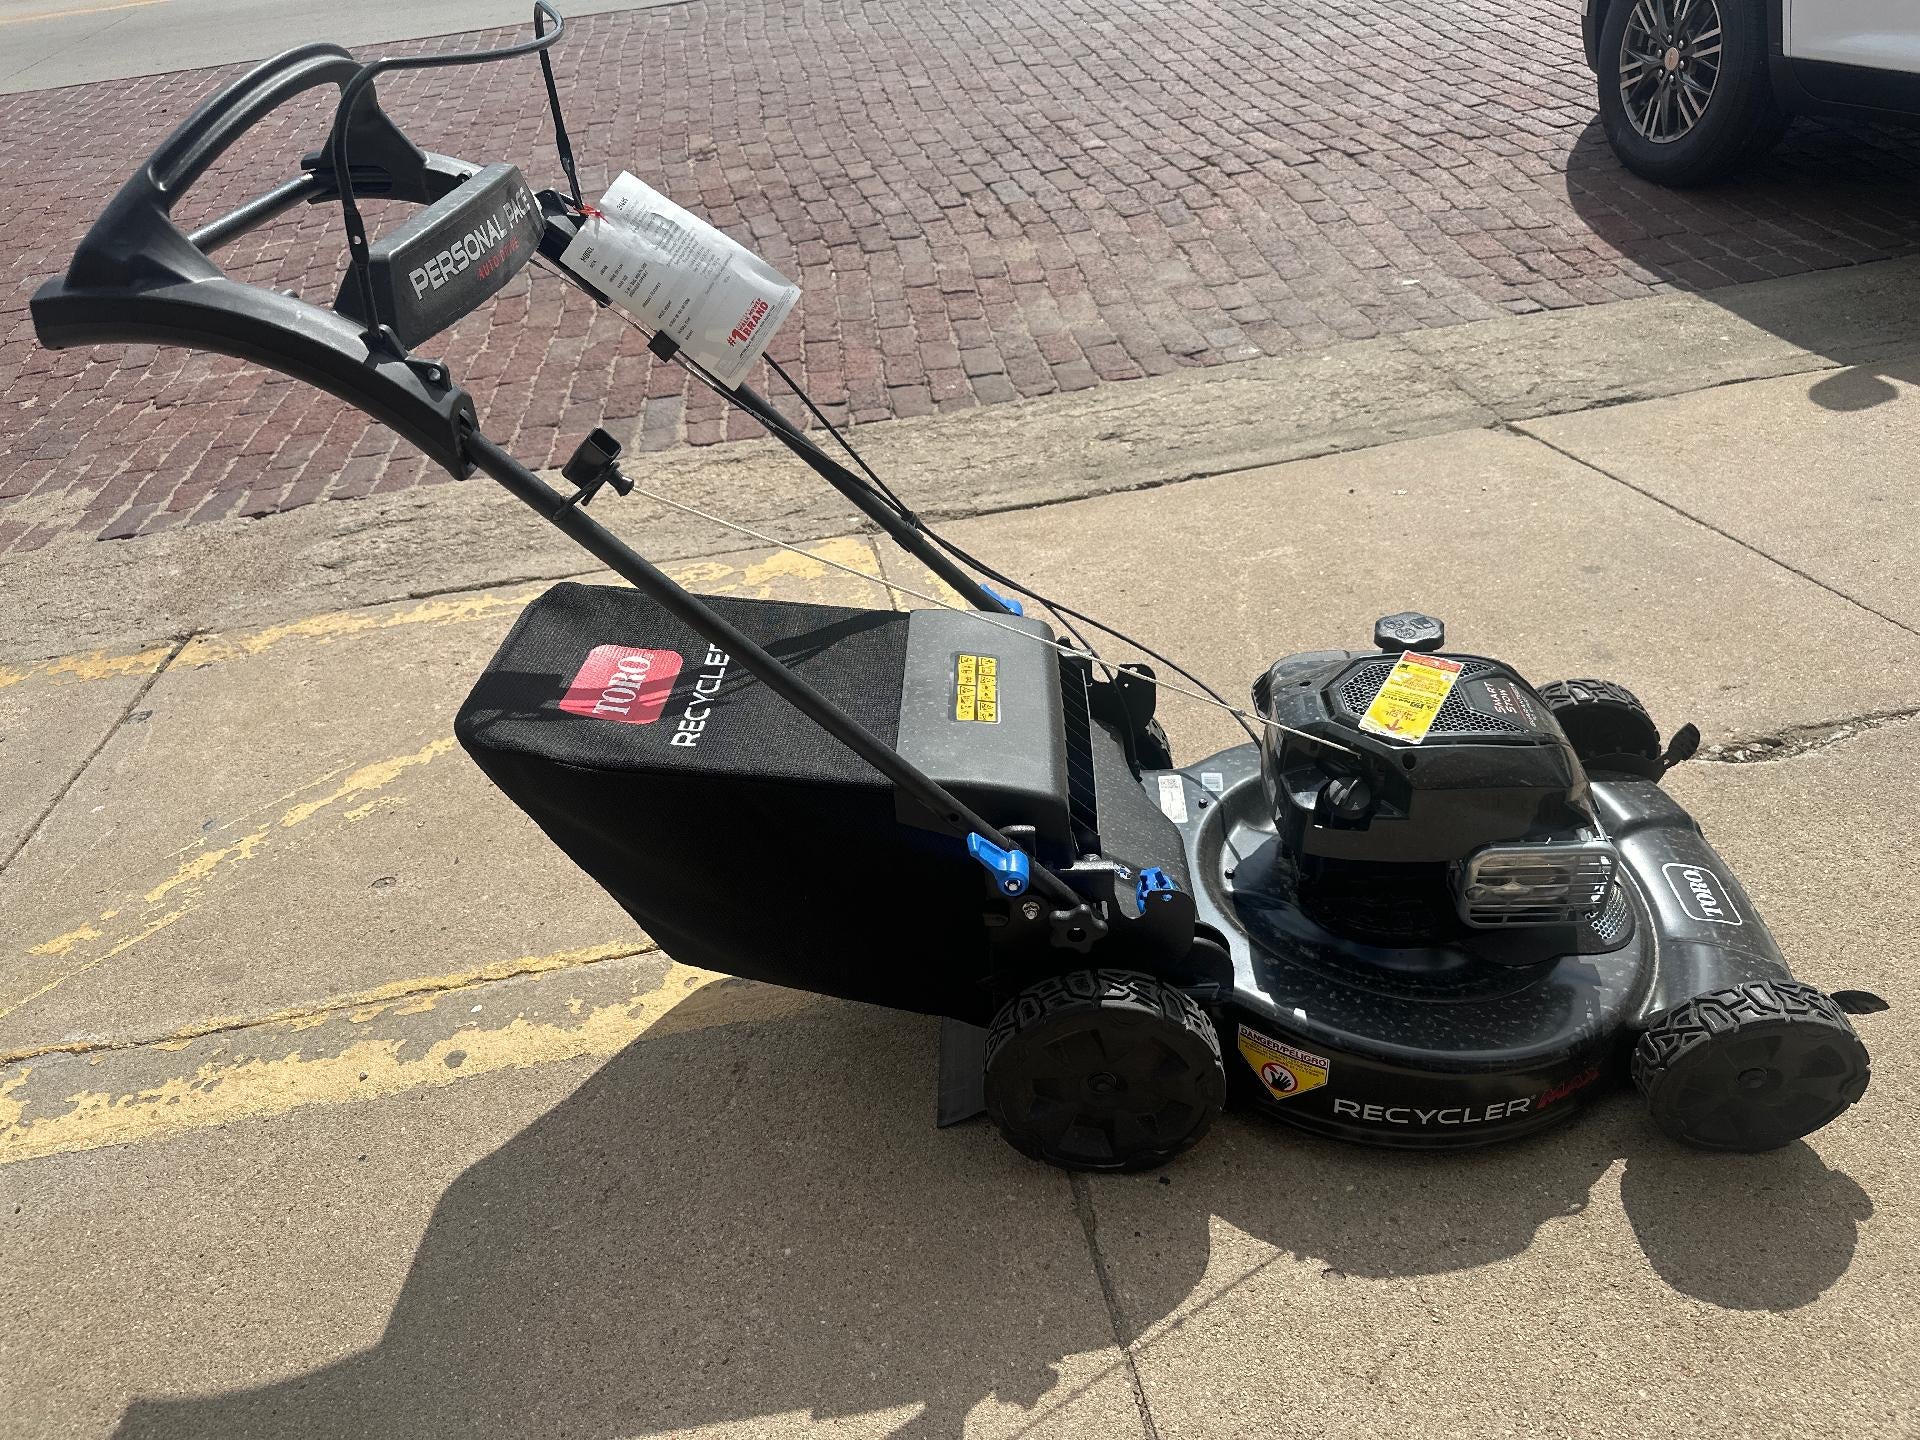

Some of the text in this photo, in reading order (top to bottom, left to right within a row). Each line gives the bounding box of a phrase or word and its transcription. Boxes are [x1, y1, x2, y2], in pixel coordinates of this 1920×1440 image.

[408, 186, 531, 301] PERSONAL PACE
[743, 301, 769, 337] BRAND
[591, 654, 650, 716] TORO
[1484, 681, 1507, 714] SMART
[1682, 869, 1724, 917] TORO
[1333, 1097, 1532, 1125] RECYCLER
